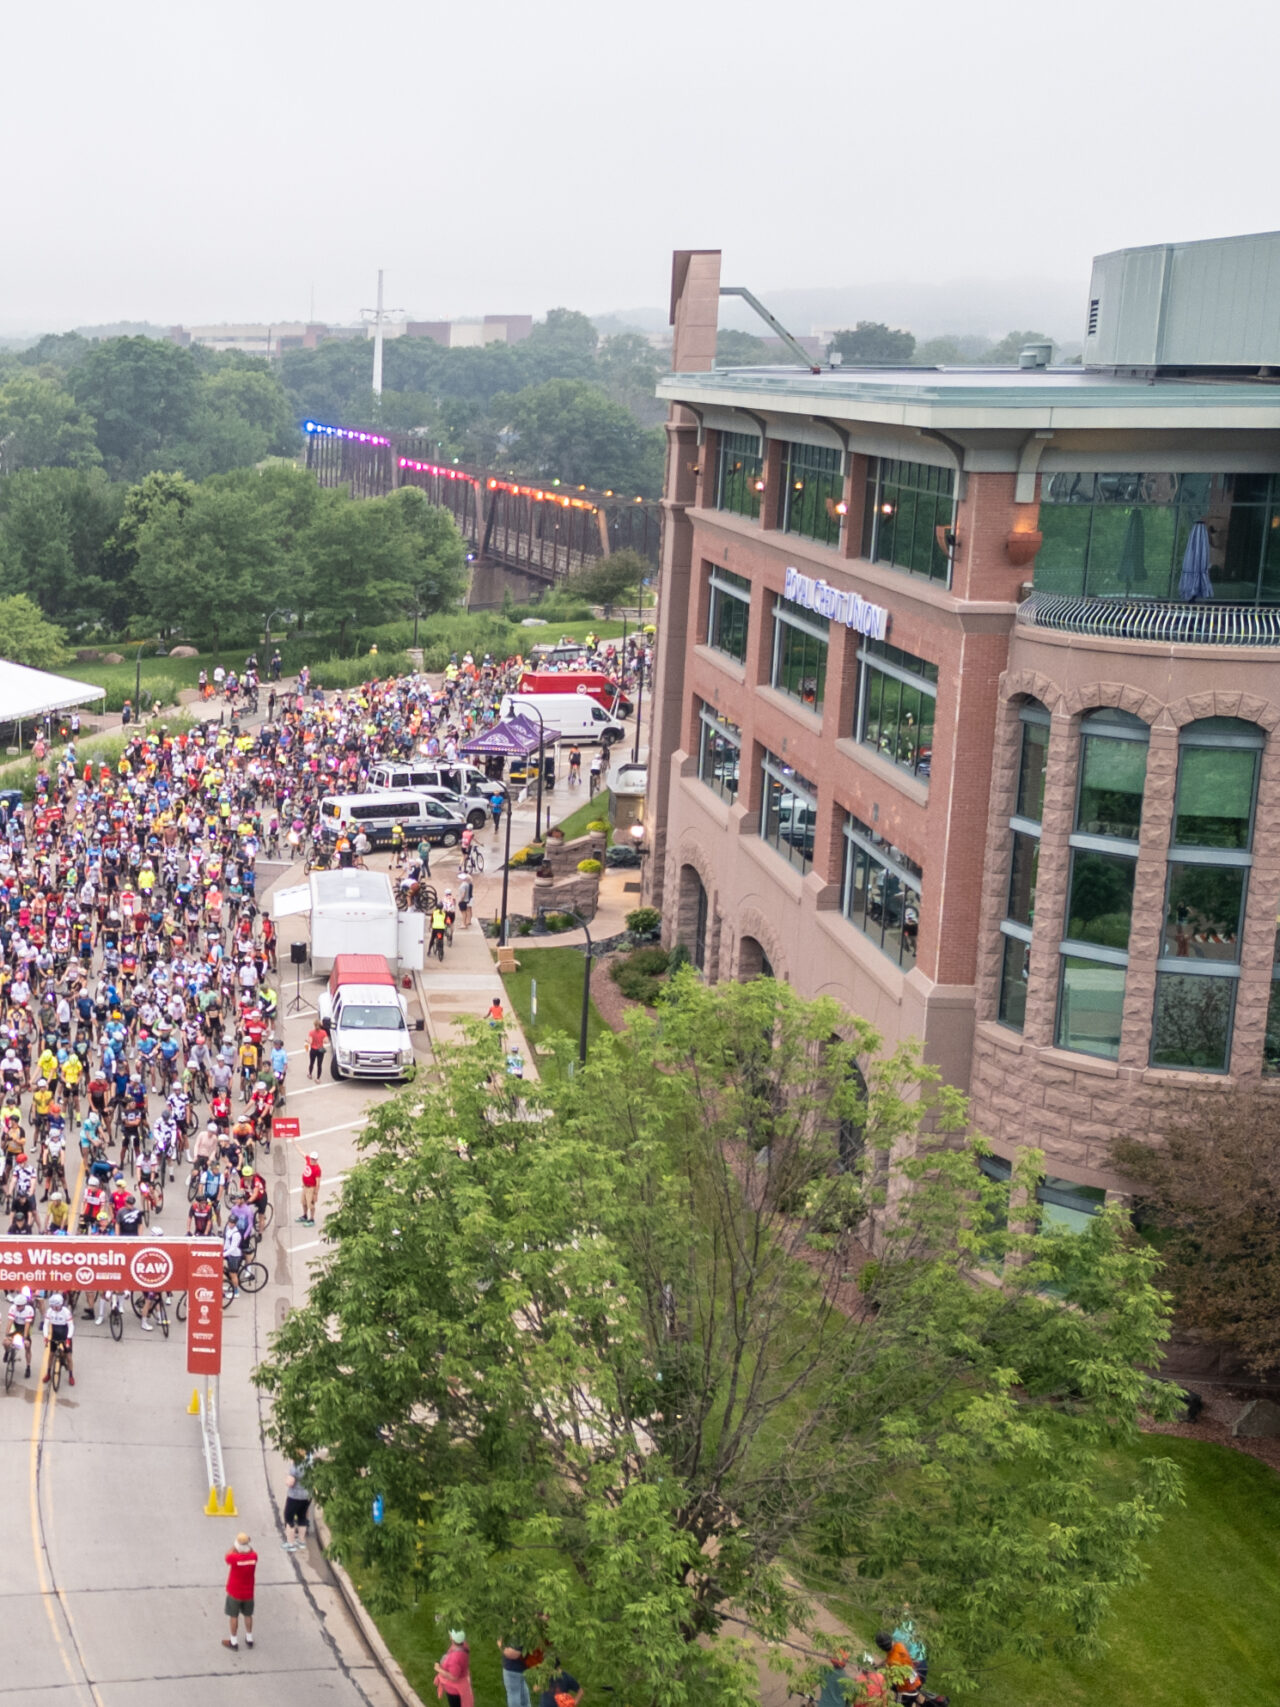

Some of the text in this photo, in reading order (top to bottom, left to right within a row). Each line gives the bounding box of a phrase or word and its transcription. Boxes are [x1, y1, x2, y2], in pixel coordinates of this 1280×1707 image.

[784, 567, 888, 640] ROYAL CREDIT UNION
[27, 1248, 126, 1266] Wisconsin
[0, 1269, 46, 1282] Benefit
[49, 1270, 73, 1282] the
[136, 1262, 168, 1274] RAW
